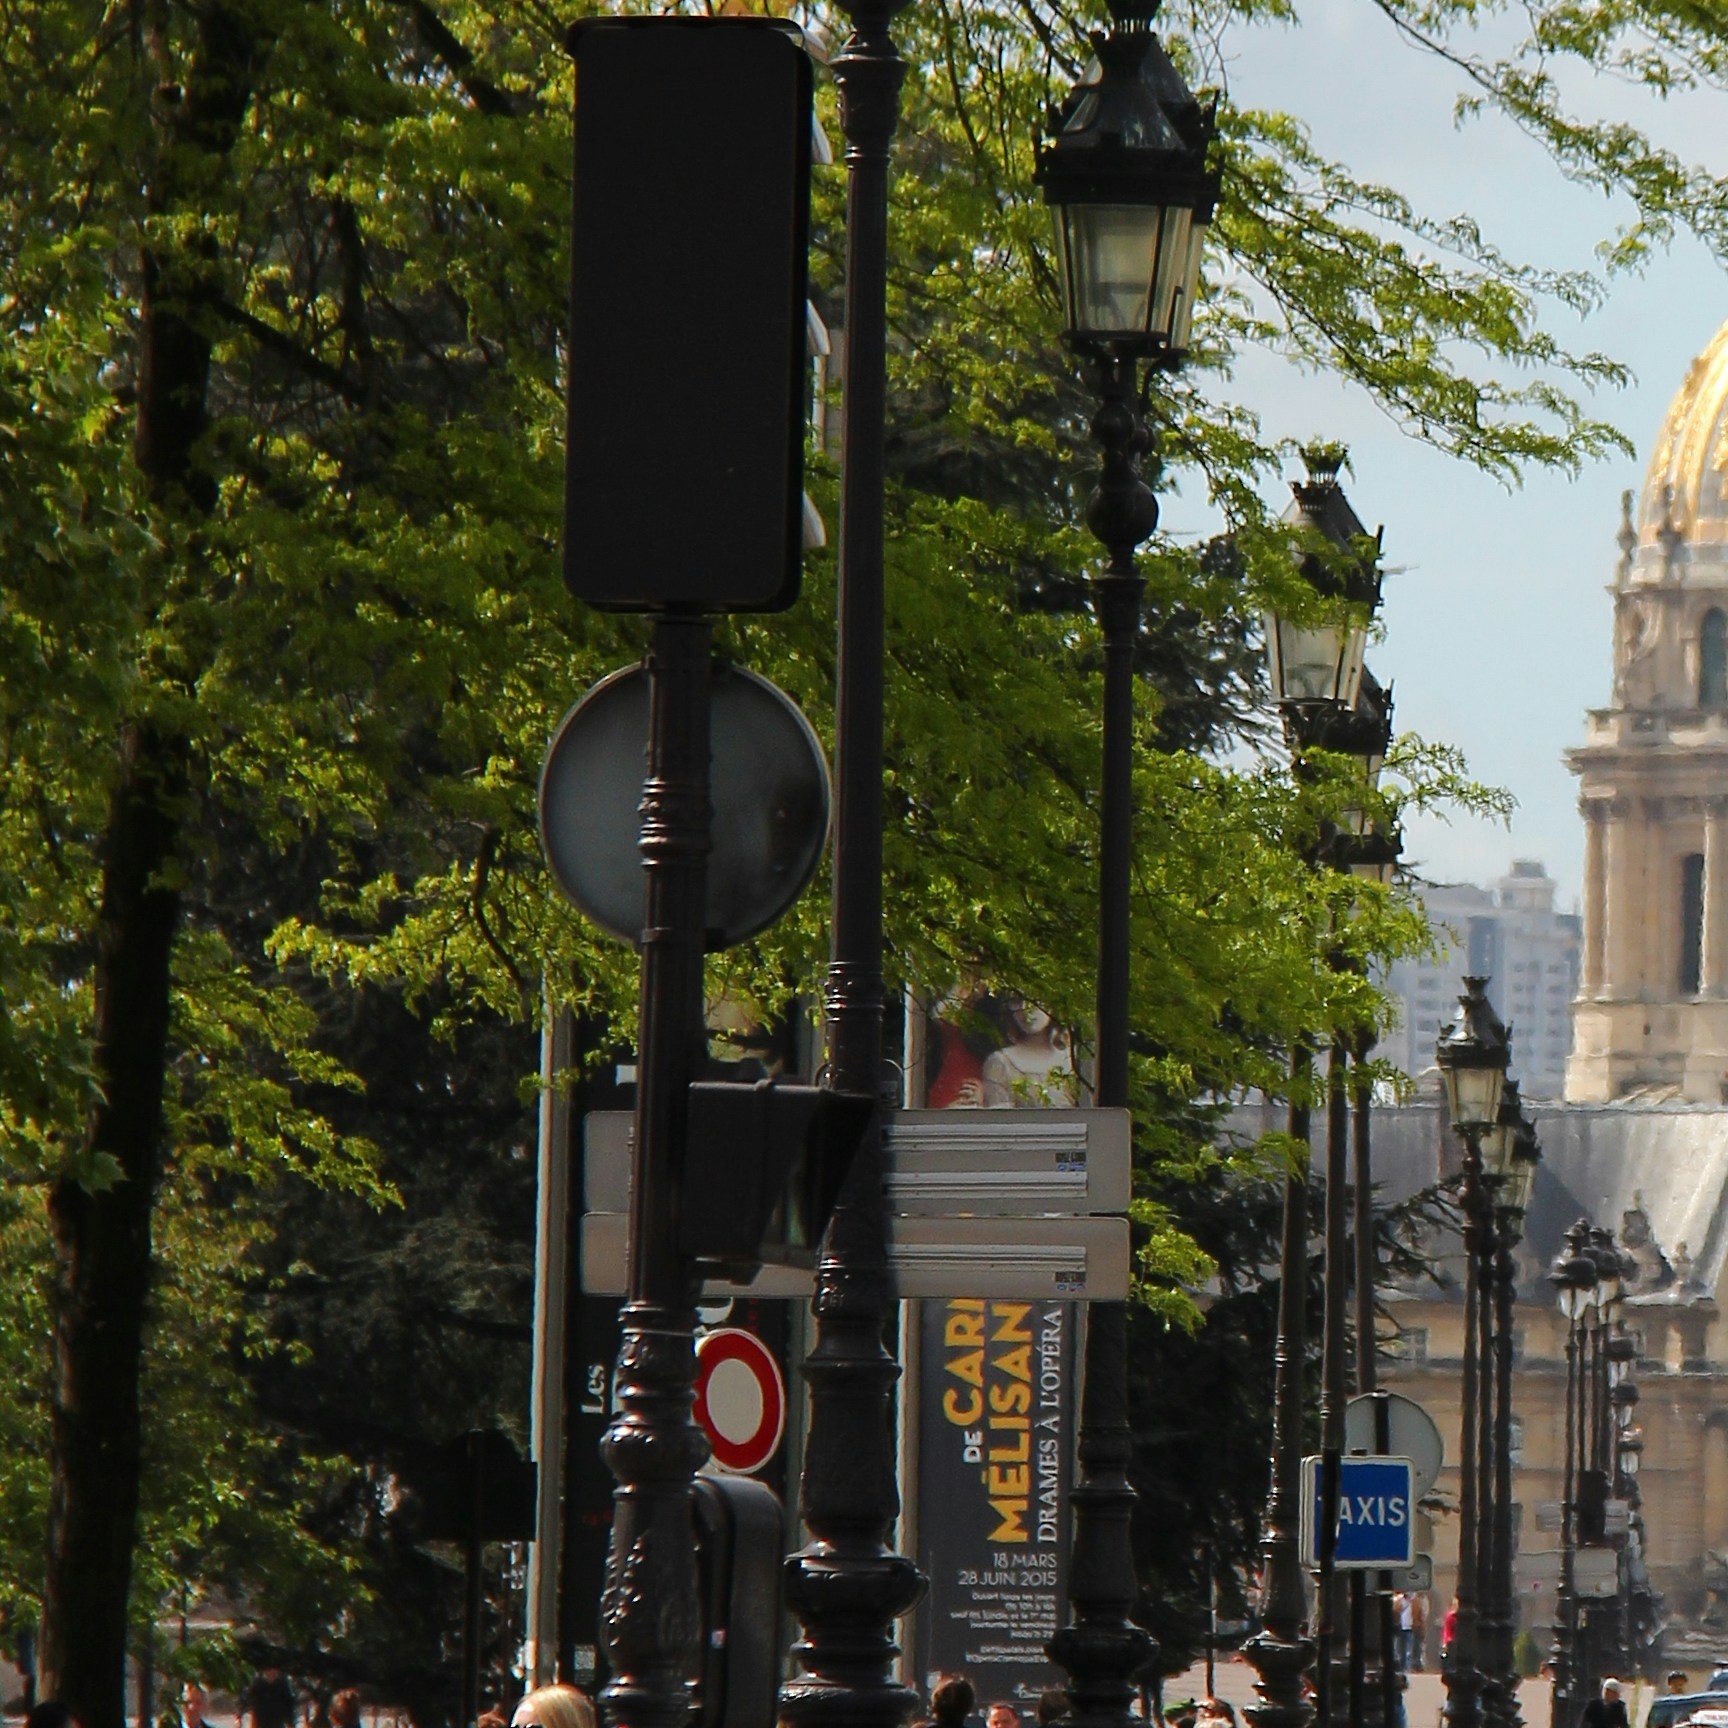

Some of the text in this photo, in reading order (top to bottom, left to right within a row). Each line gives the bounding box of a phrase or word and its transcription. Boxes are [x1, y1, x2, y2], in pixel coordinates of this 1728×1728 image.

[943, 1298, 985, 1463] DE CAR
[1036, 1308, 1062, 1407] L'OPÉRA
[581, 1363, 604, 1414] Les
[981, 1301, 1033, 1543] MÉLISAN
[1034, 1414, 1061, 1433] À
[1037, 1439, 1059, 1543] DRAMES
[1317, 1496, 1407, 1527] AXIS
[957, 1571, 1057, 1586] 28 JUIN 2015
[993, 1553, 1057, 1569] 18 MARS
